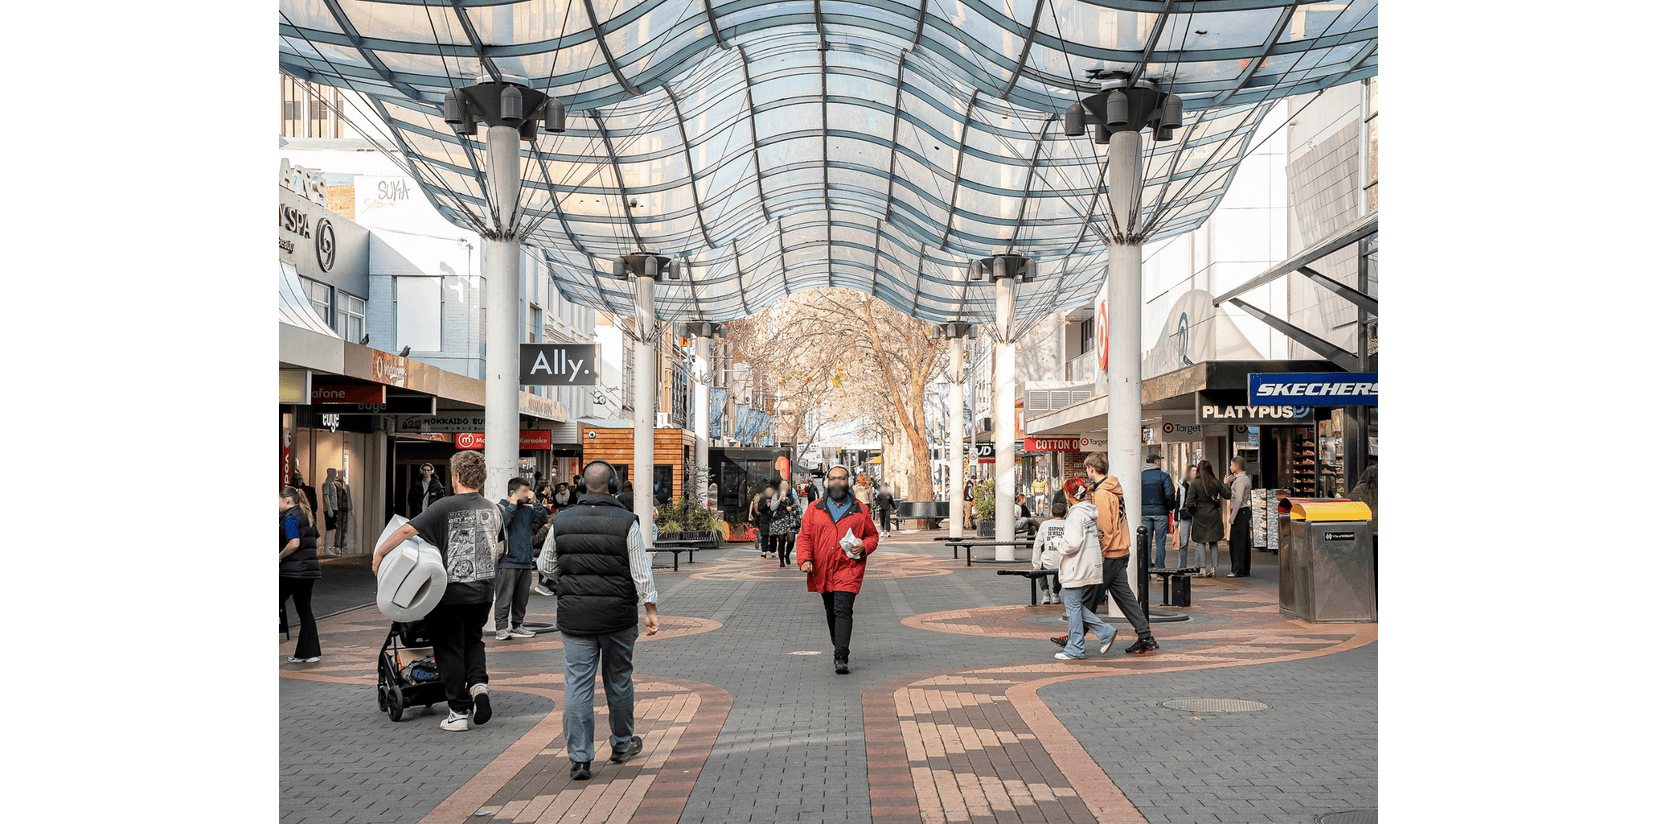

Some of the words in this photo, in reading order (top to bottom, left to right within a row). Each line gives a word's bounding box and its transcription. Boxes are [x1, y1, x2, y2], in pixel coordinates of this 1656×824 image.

[530, 348, 589, 382] Ally.
[1202, 405, 1294, 419] PLATYPUS
[423, 417, 469, 425] HOKKAIDO
[1175, 424, 1201, 435] Target
[1035, 440, 1070, 449] COTTON
[1089, 438, 1108, 447] Target
